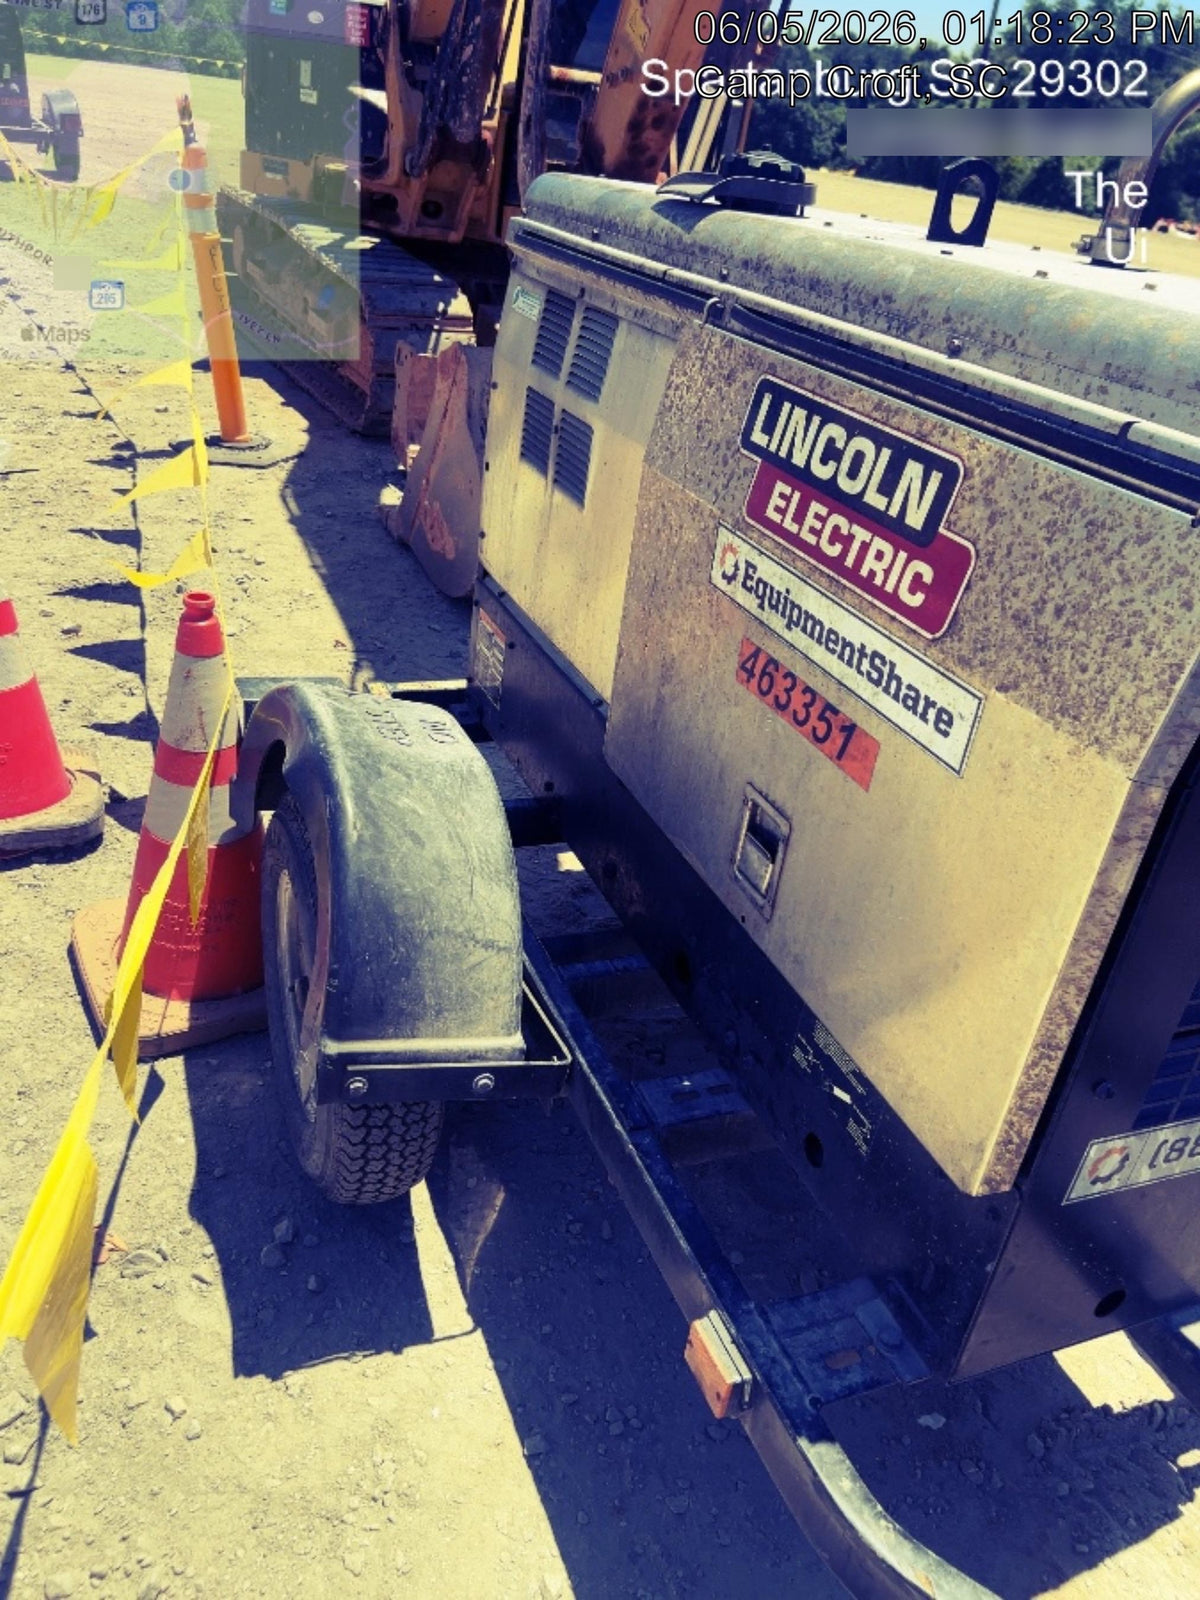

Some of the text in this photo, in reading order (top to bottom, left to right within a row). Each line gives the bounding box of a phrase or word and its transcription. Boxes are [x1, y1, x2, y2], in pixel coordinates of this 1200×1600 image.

[749, 392, 943, 531] LINCOLN
[764, 479, 935, 608] ELECTRIC
[739, 646, 859, 762] 463351
[740, 558, 955, 739] EquipmentShare
